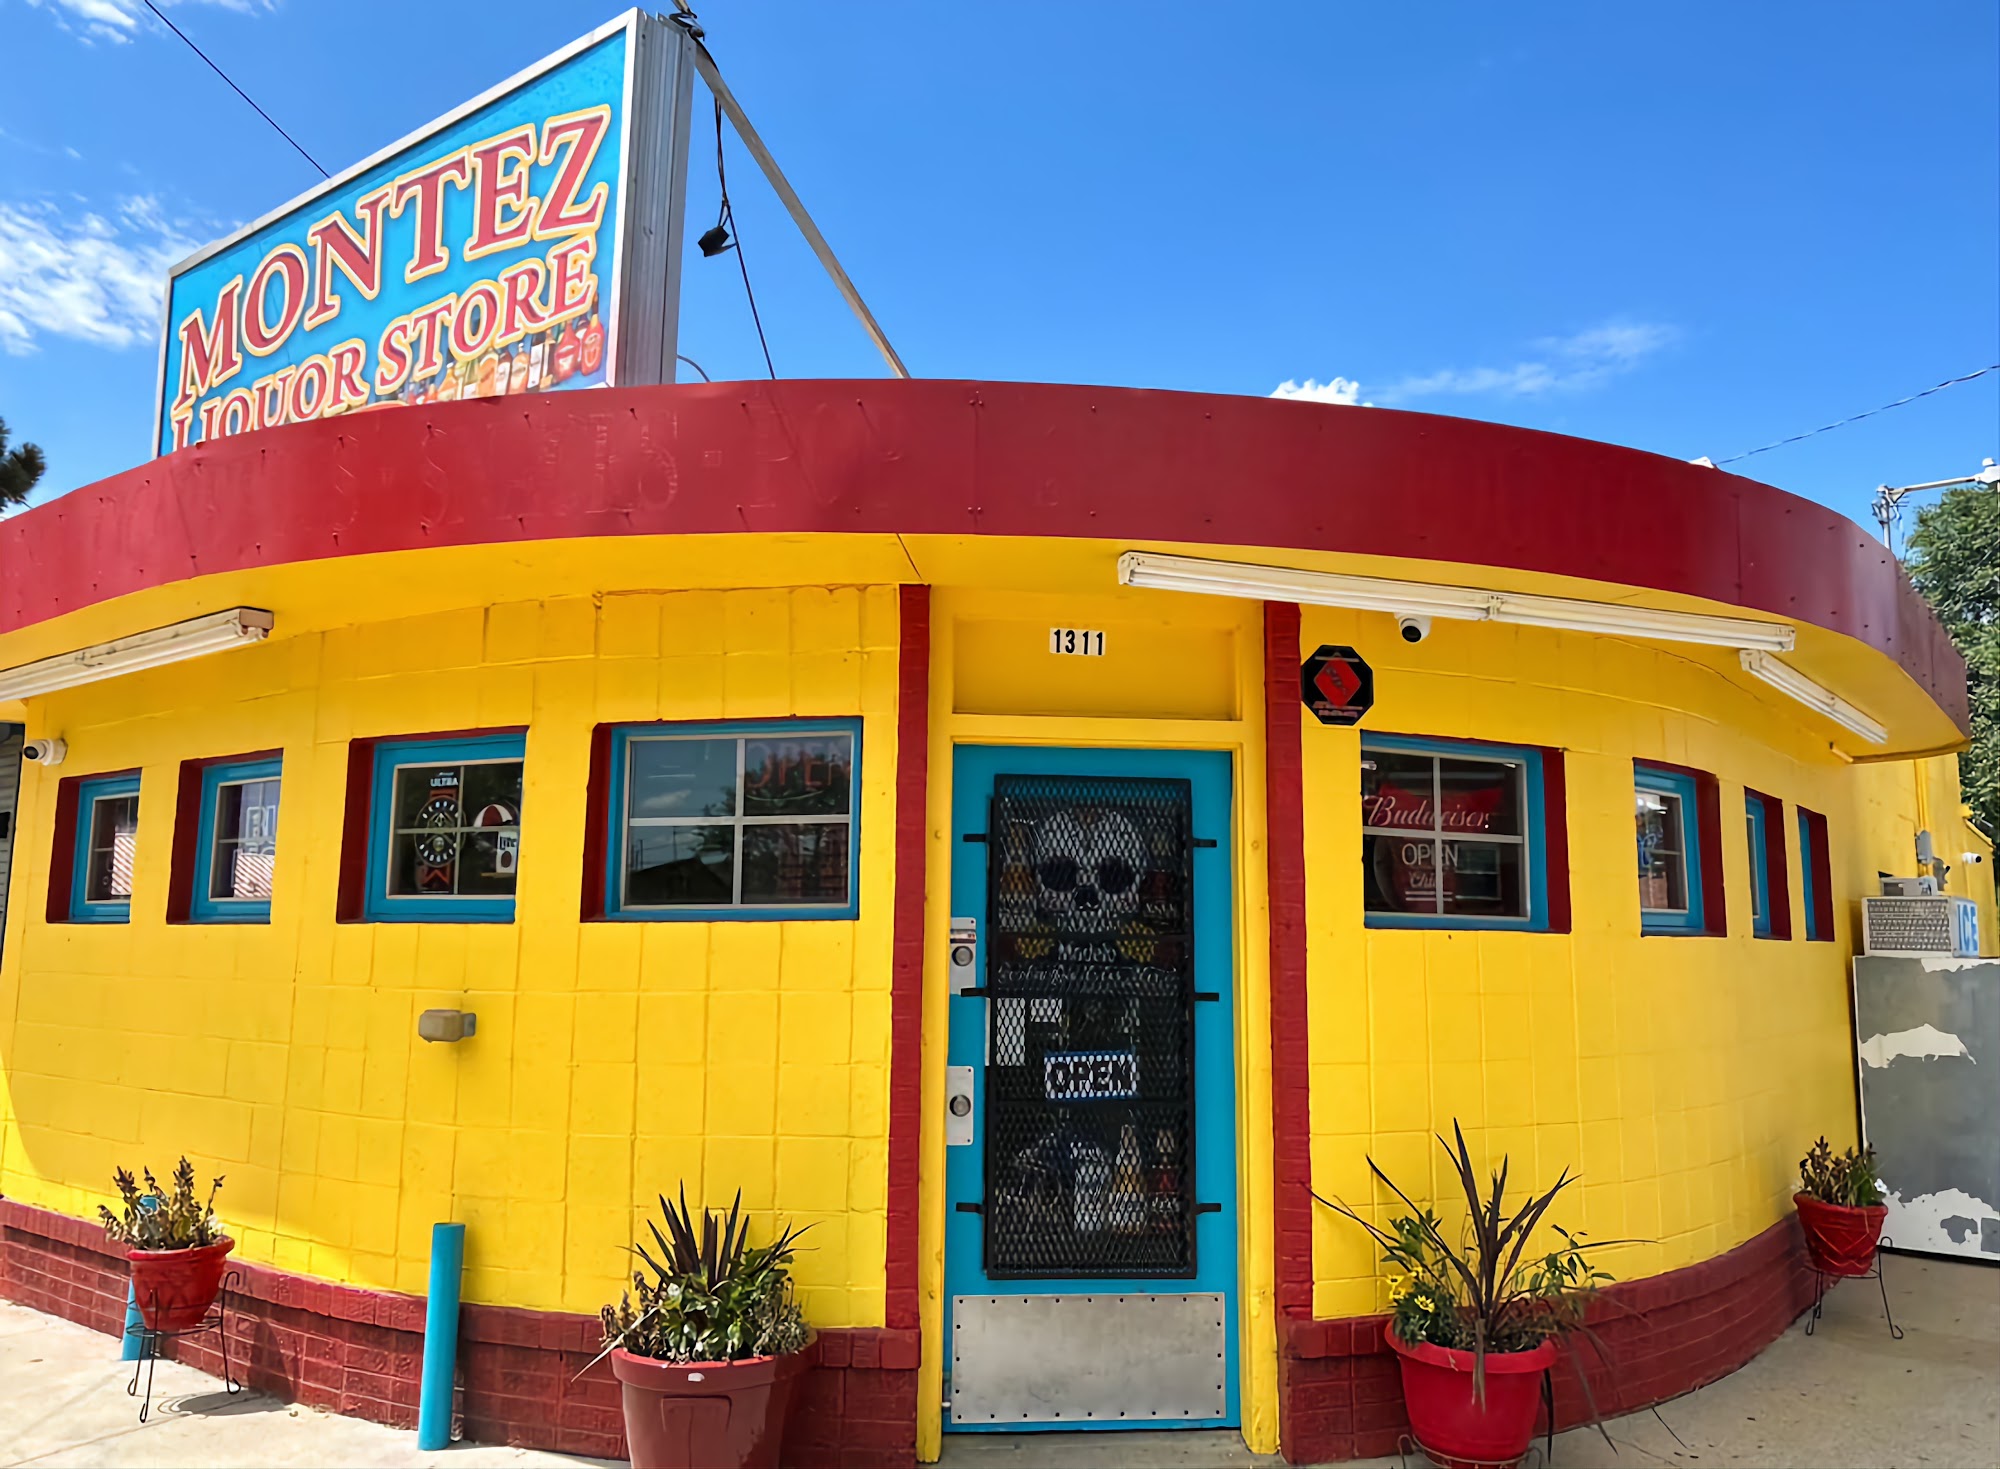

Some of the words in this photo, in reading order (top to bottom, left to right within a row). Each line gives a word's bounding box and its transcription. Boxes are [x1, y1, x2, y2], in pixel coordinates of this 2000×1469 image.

[173, 104, 611, 412] MONTEZ
[171, 338, 369, 451] LIQUOR
[374, 232, 597, 394] STORE
[1053, 629, 1104, 656] 1311
[430, 777, 459, 787] ULTRA
[1957, 903, 1979, 952] ICE
[1050, 1060, 1132, 1093] OPEN
